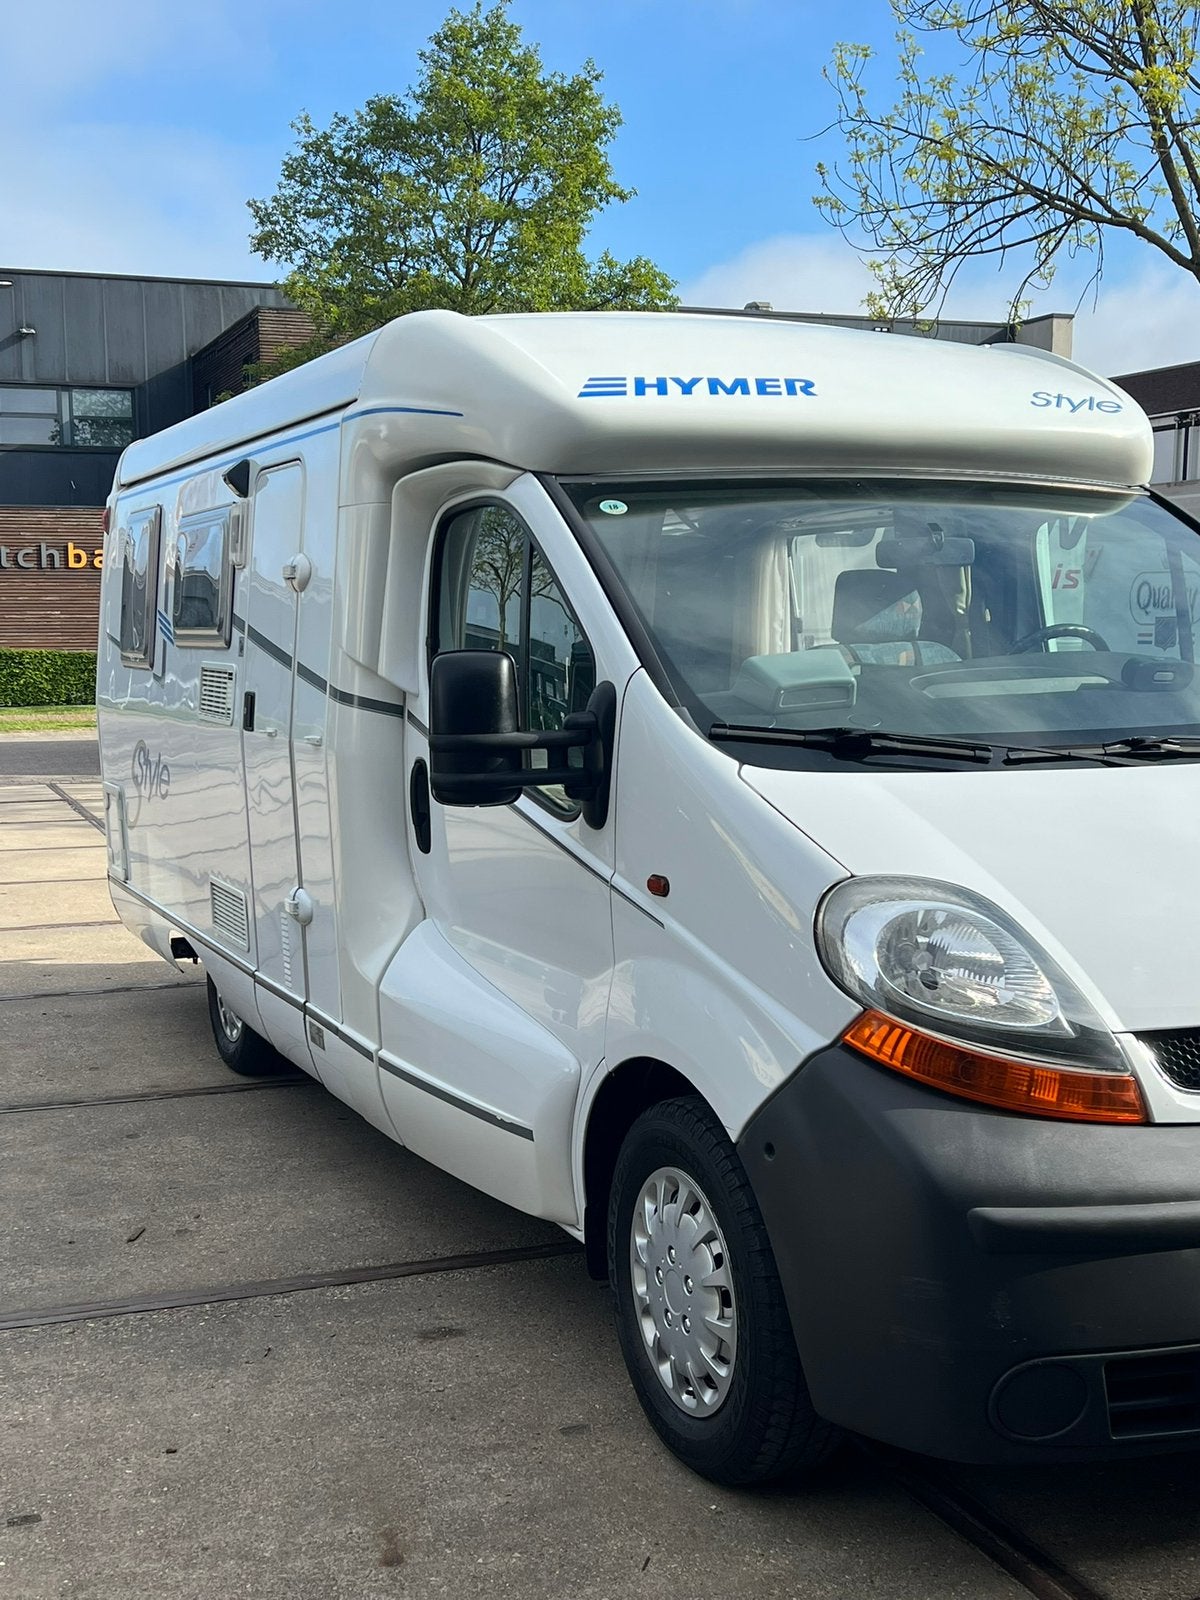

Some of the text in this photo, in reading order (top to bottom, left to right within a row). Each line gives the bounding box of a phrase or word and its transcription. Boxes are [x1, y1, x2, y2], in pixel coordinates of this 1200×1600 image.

[634, 376, 818, 396] HYMER
[1030, 391, 1123, 414] Style
[131, 739, 170, 803] Style
